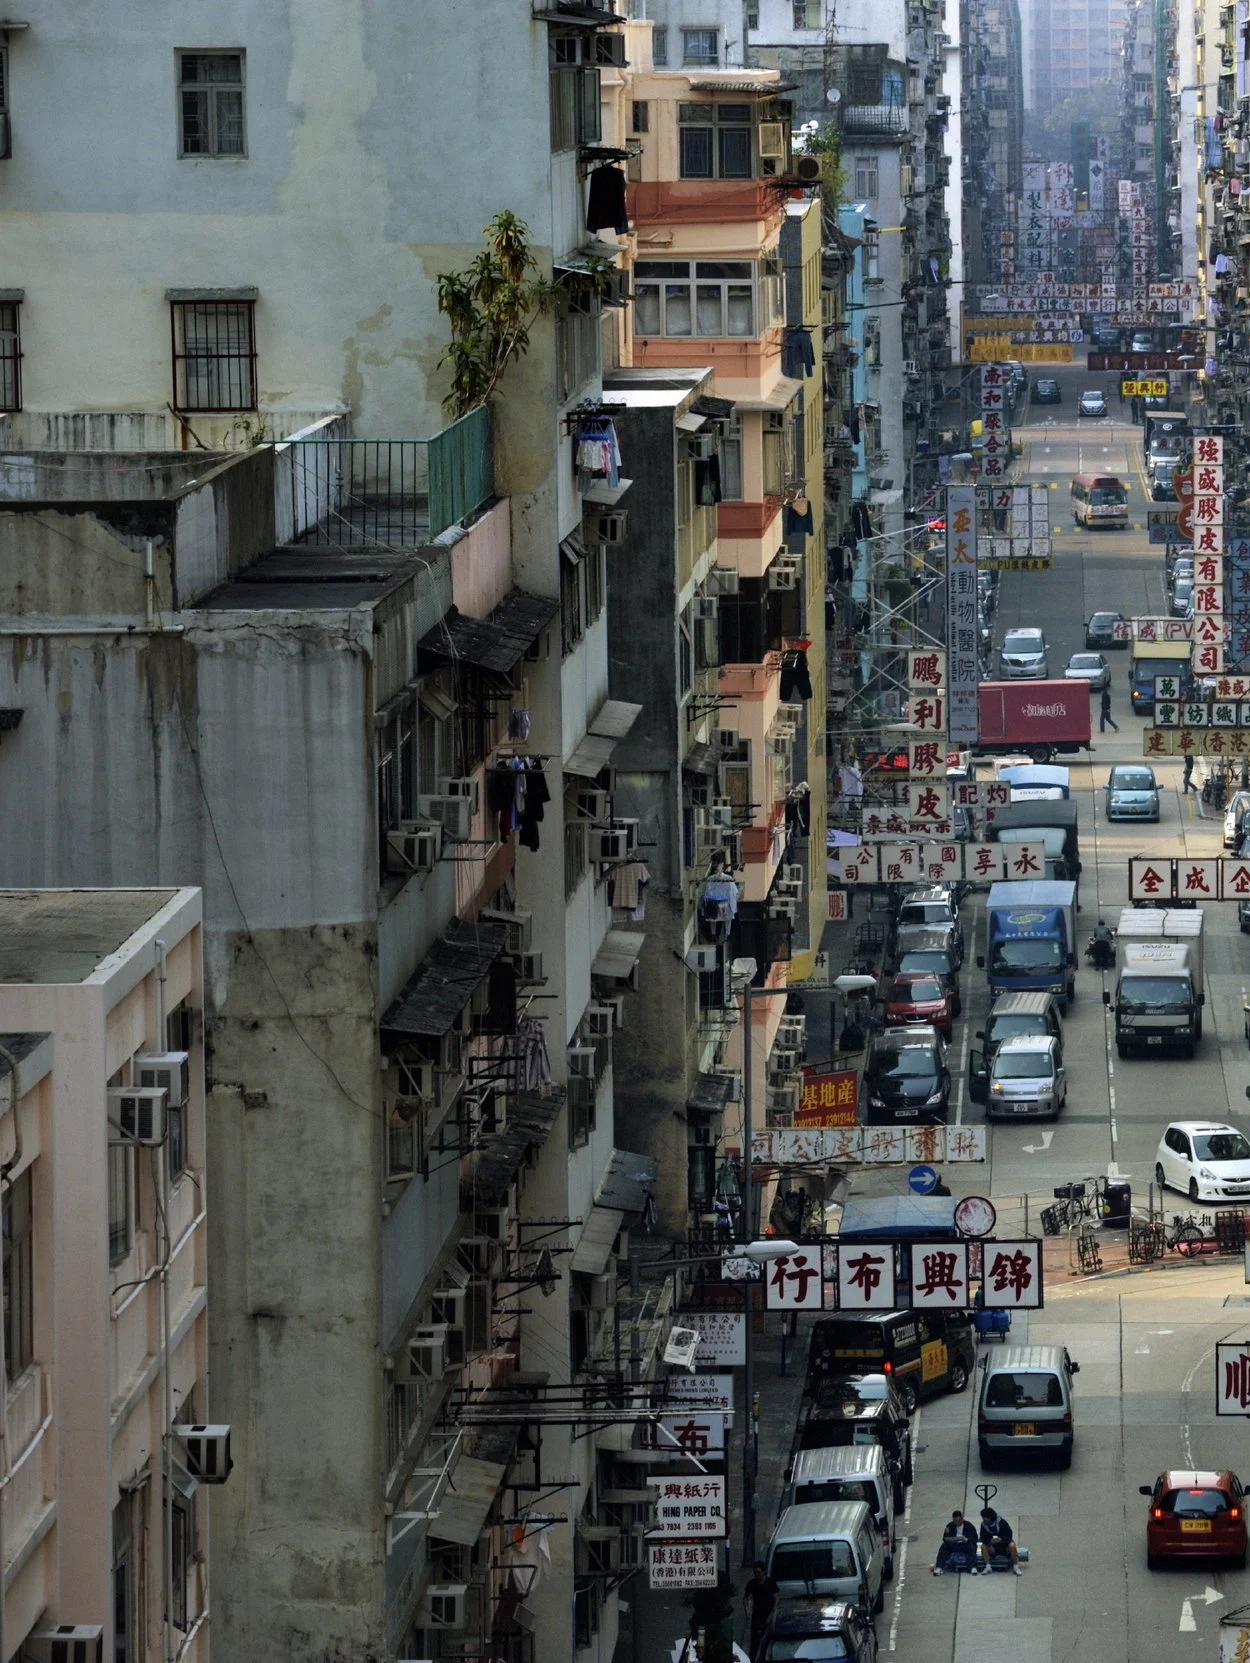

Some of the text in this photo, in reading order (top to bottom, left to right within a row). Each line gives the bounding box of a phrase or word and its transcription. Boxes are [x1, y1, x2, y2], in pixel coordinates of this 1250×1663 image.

[1196, 437, 1221, 672] 強盛膠皮有限公司
[912, 653, 945, 821] 鵬利膠皮
[662, 1506, 681, 1518] HING
[683, 1505, 707, 1518] PAPER
[652, 1566, 715, 1578] (香港)有限公司
